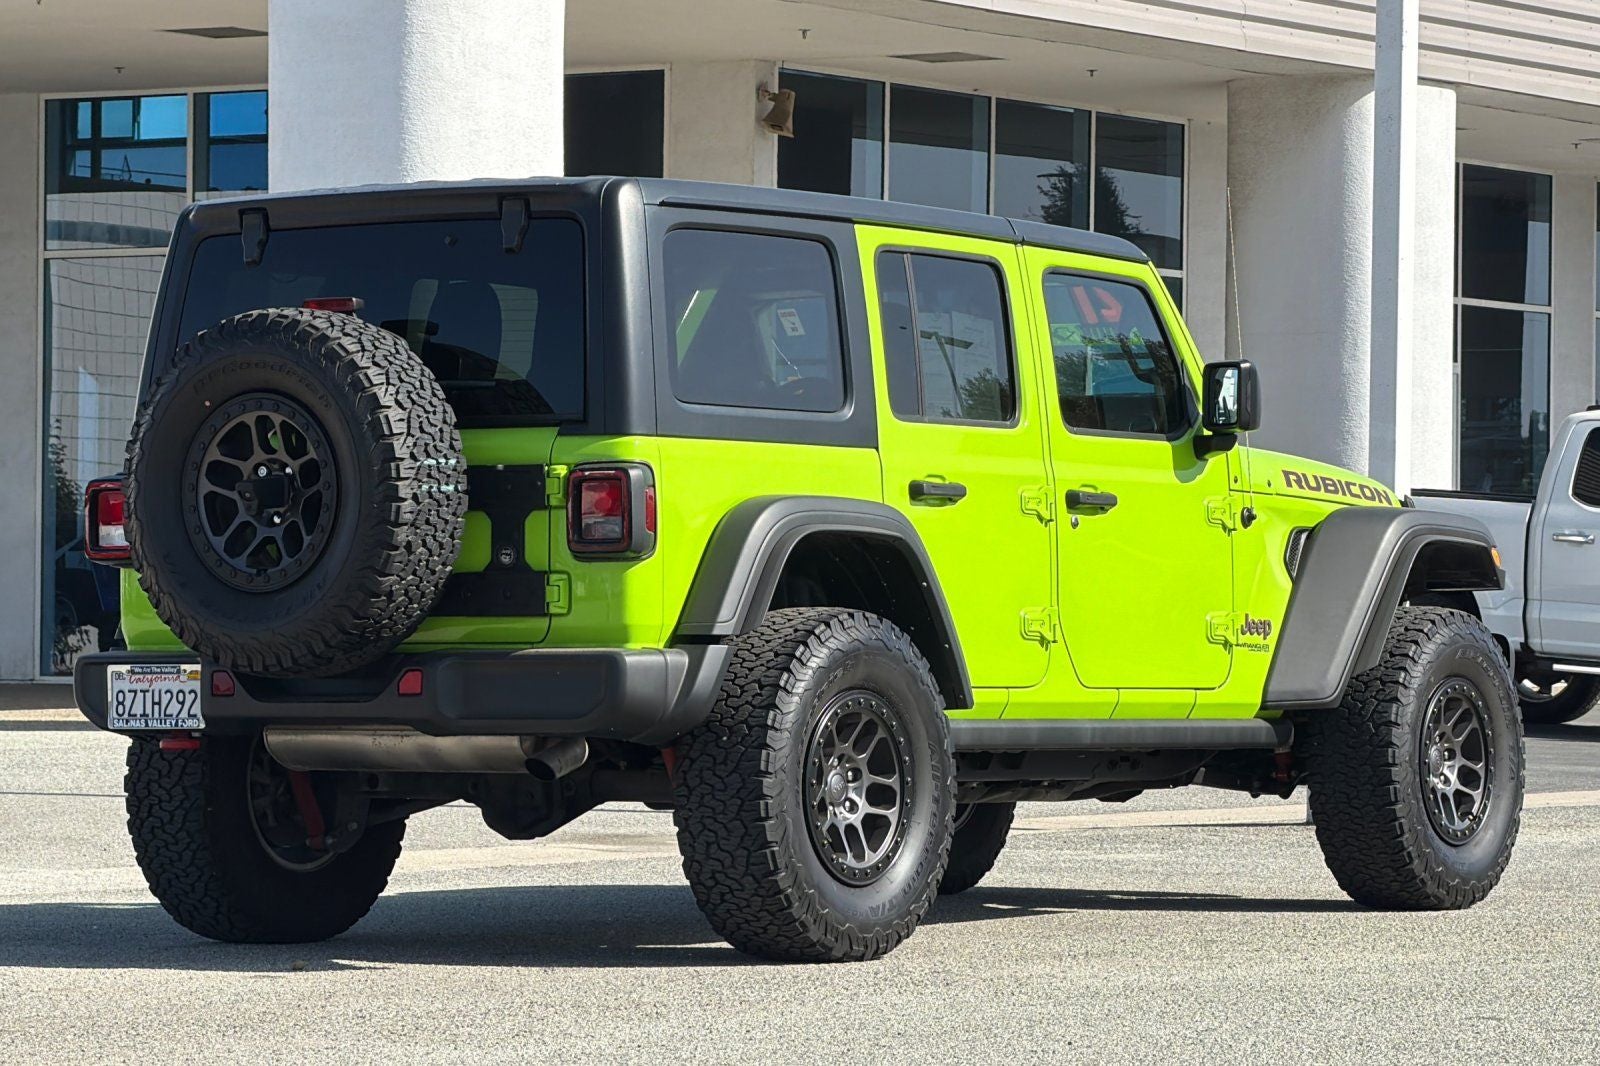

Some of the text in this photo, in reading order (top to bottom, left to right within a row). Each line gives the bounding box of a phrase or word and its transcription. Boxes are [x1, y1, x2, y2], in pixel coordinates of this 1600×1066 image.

[1281, 470, 1393, 506] RUBICON
[1240, 613, 1272, 641] Jeep
[128, 674, 188, 687] California
[115, 689, 198, 719] 8ZIH292
[148, 719, 177, 728] VALLEY
[178, 719, 199, 728] FORD
